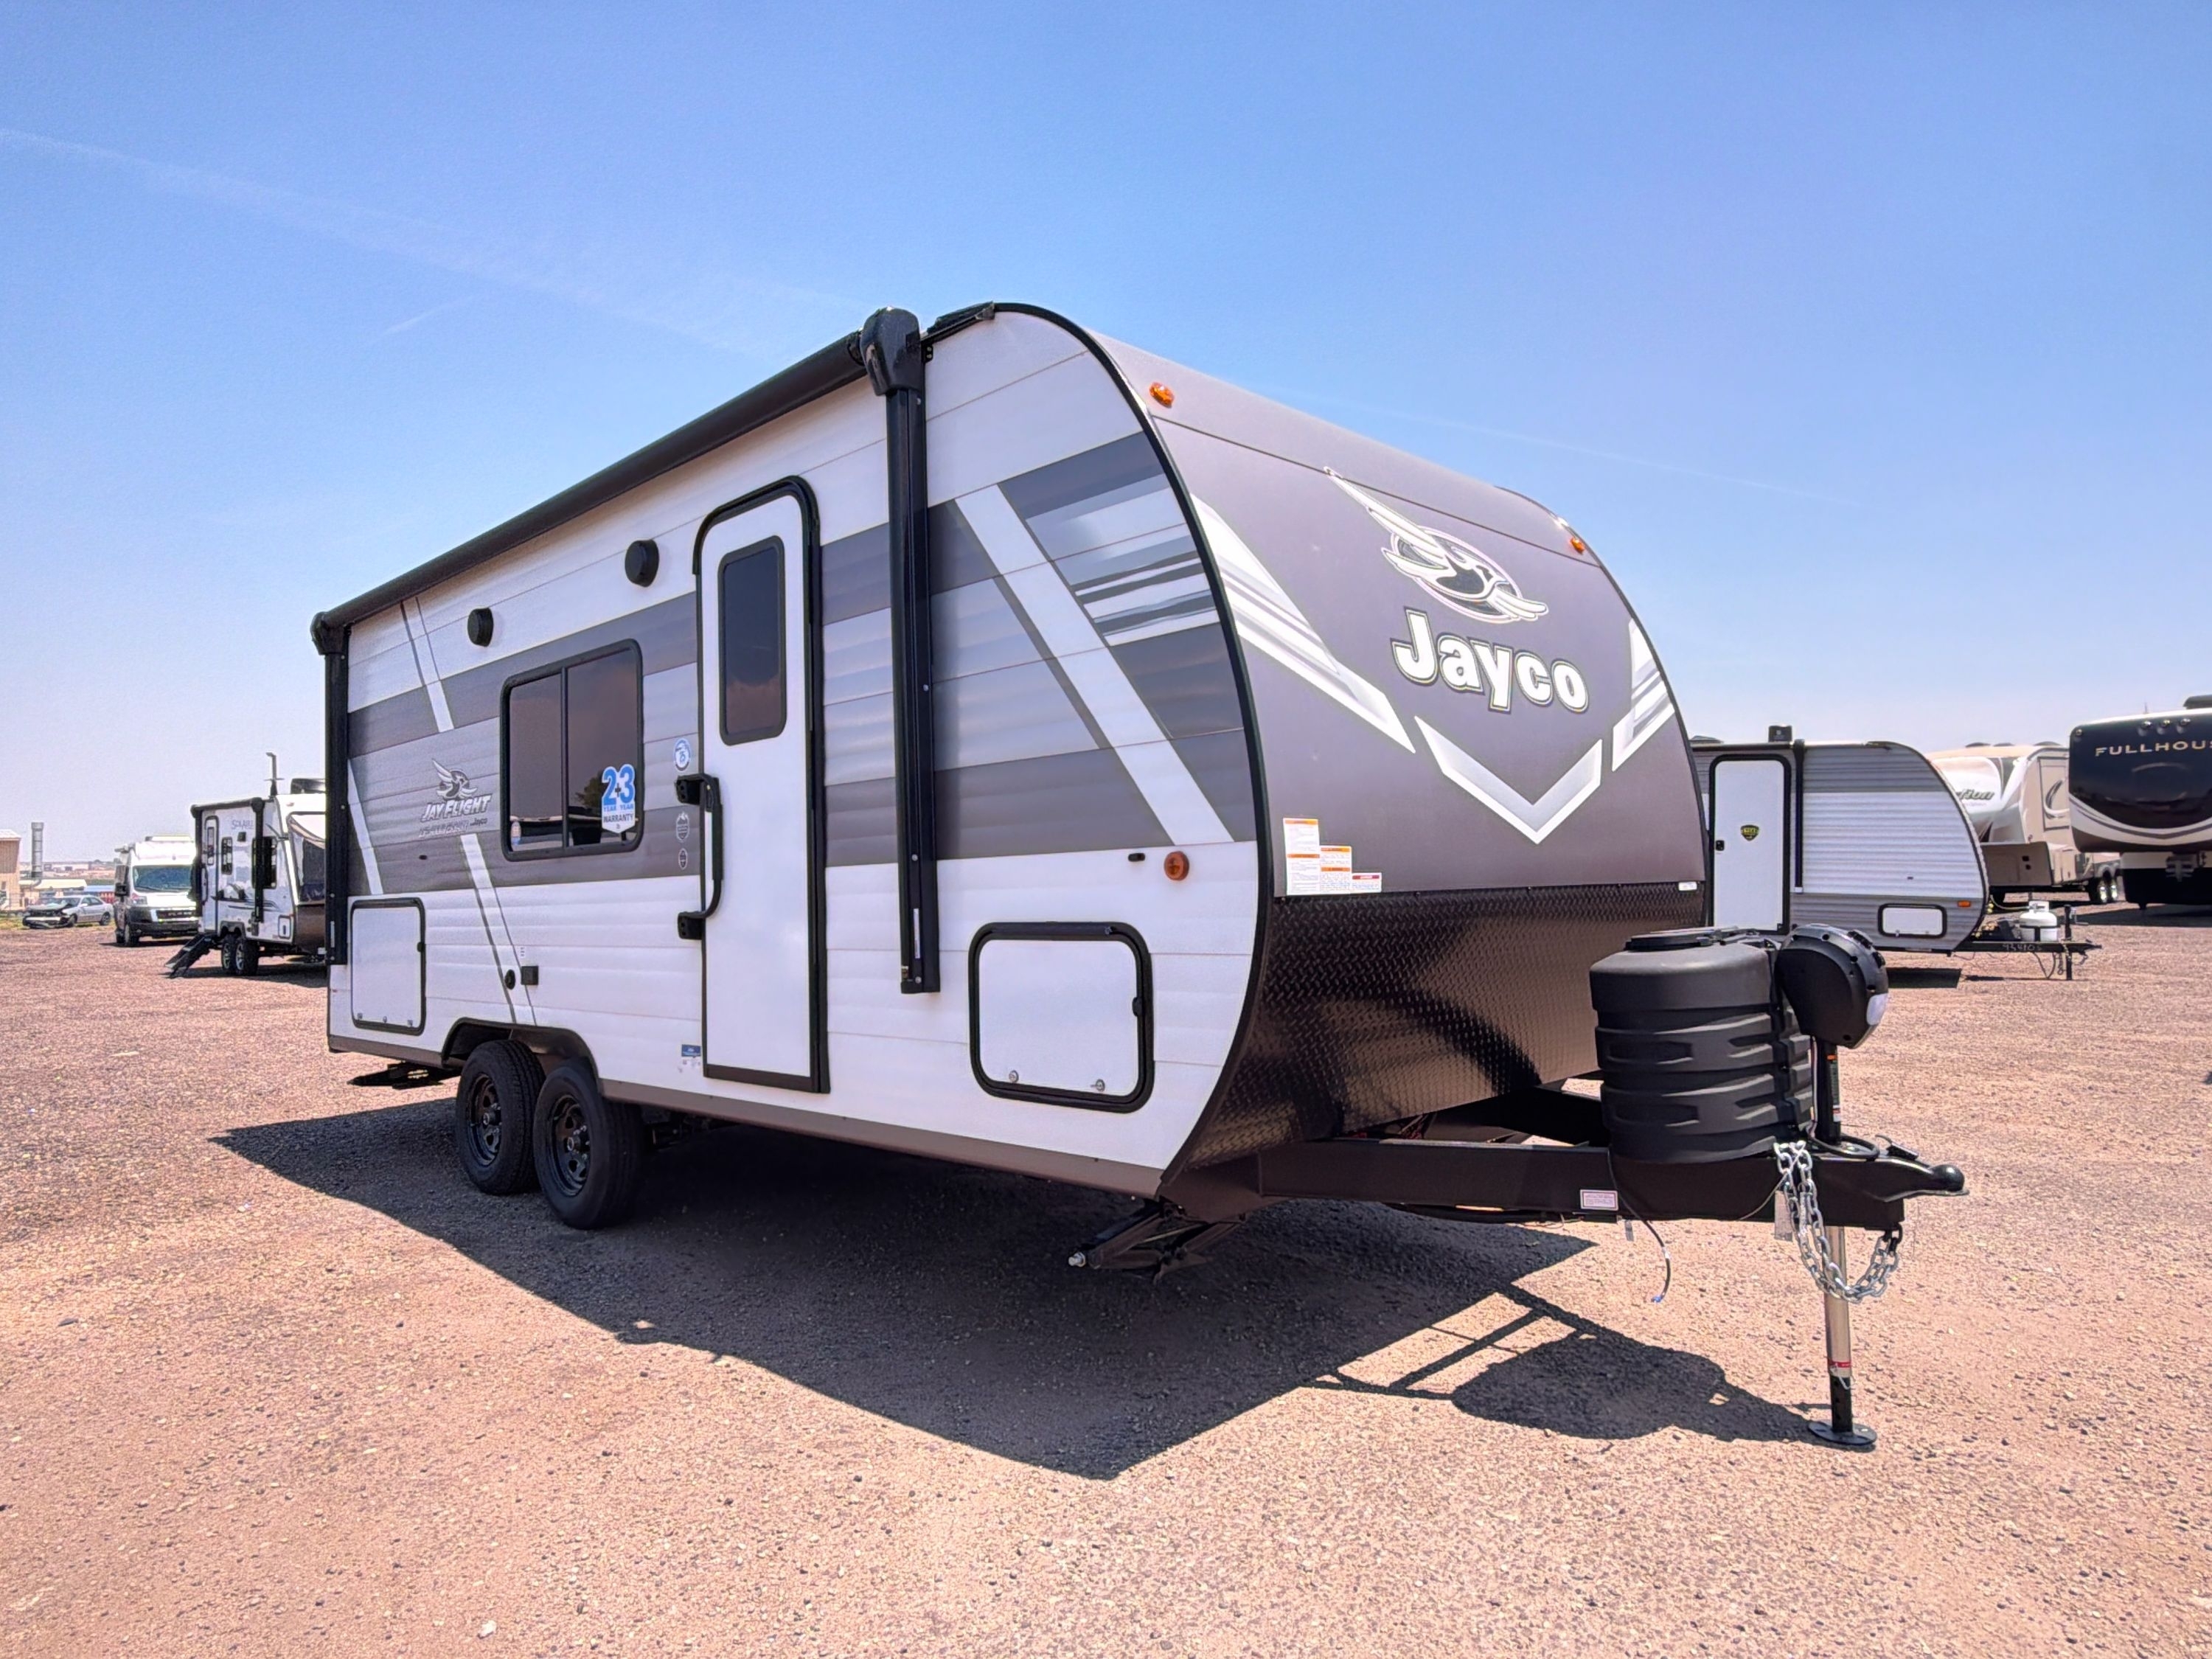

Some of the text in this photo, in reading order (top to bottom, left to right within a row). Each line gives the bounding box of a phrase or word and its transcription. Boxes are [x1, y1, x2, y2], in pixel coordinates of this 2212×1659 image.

[1391, 607, 1589, 714] Jayco
[2095, 740, 2212, 757] FULLHOU
[421, 794, 492, 822] JAY FLIGHT
[604, 813, 633, 822] WARRANTY
